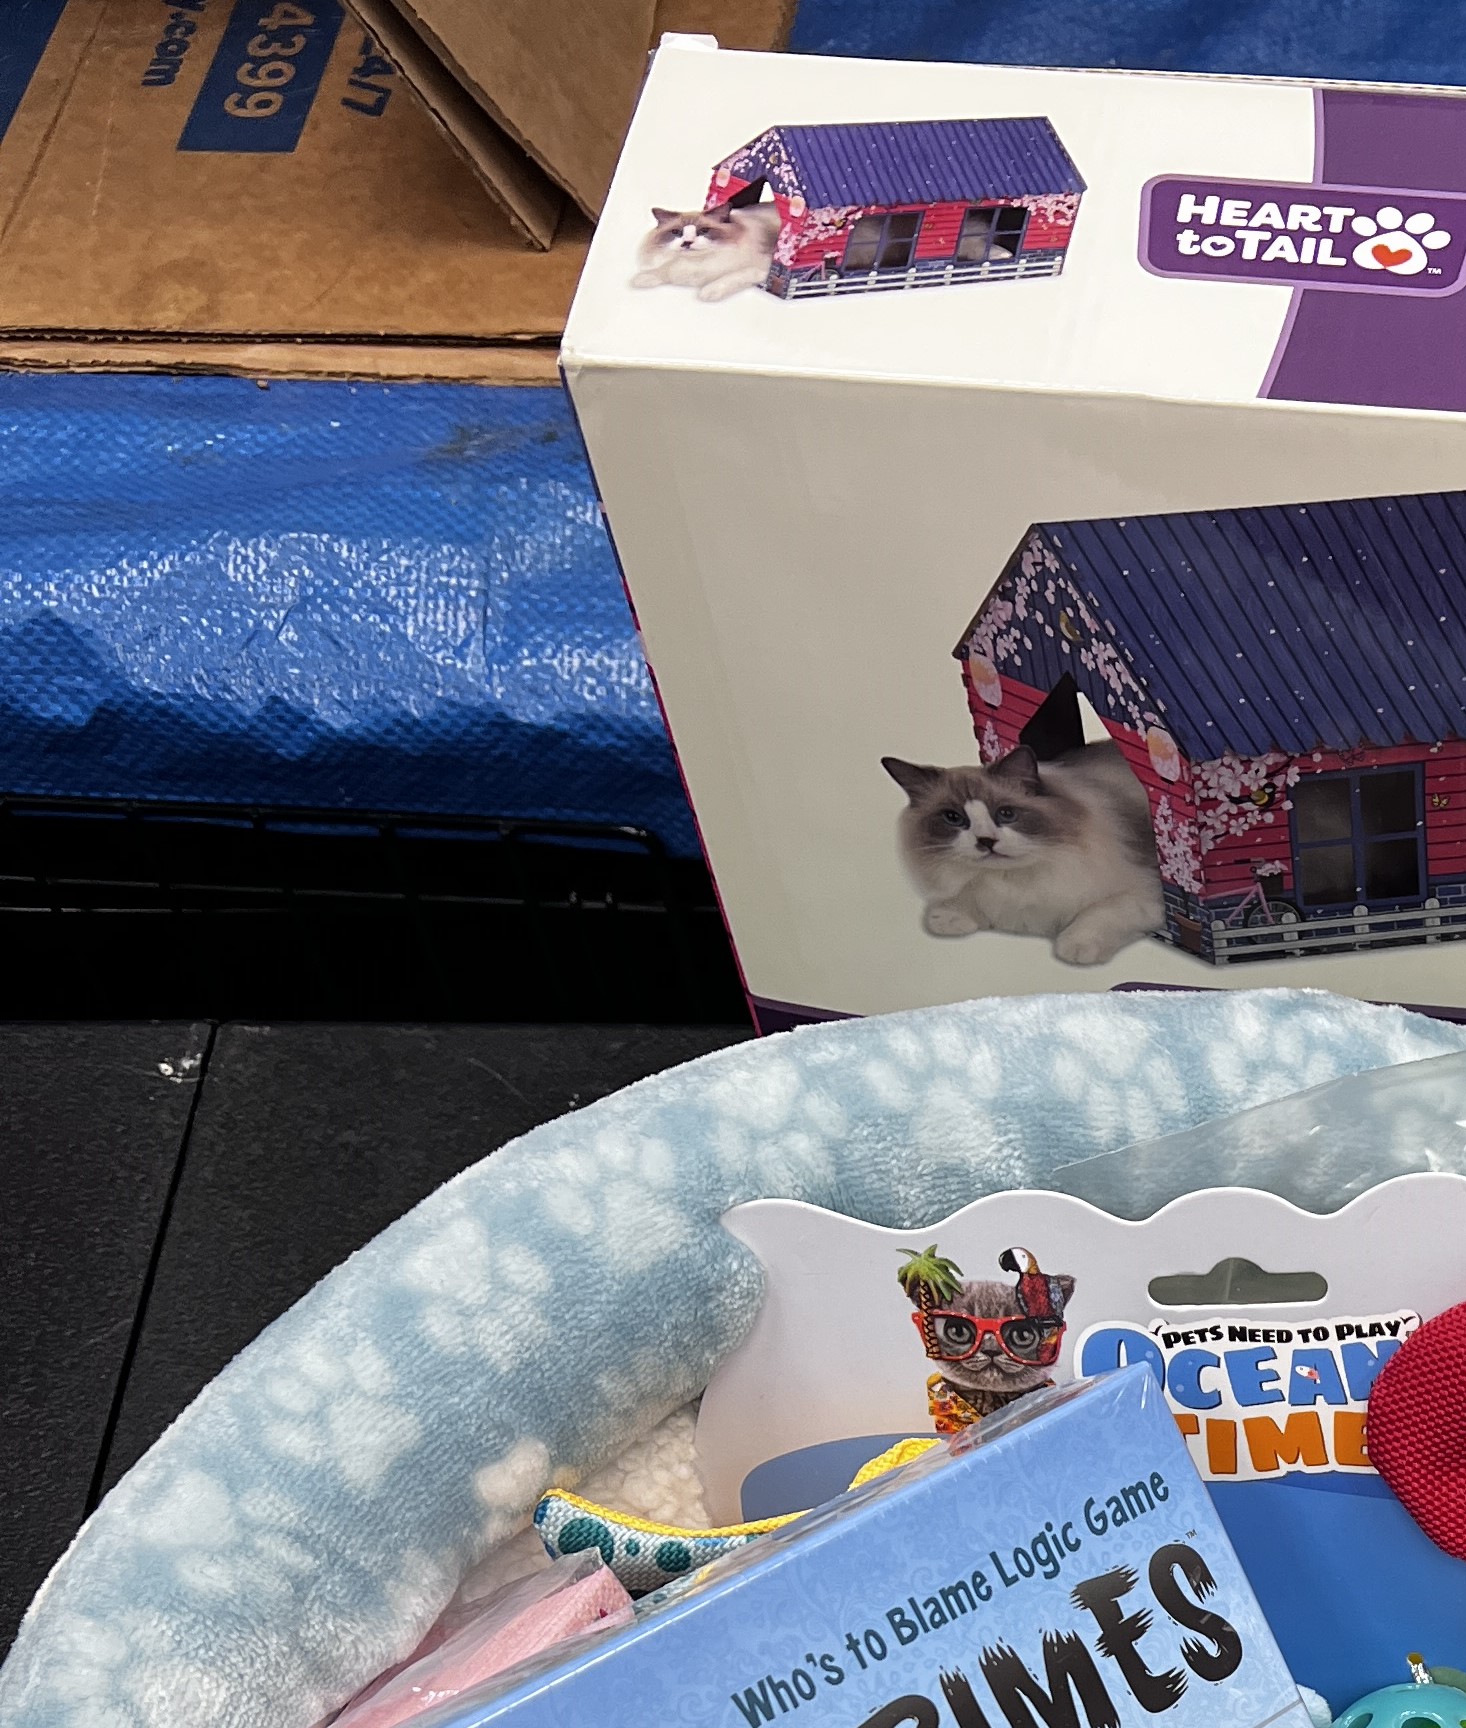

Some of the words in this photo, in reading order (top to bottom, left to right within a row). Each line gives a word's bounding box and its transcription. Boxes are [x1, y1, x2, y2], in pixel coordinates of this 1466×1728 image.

[223, 3, 316, 118] 4399
[1176, 193, 1355, 233] HEART
[1161, 1325, 1224, 1349] PETS
[1228, 1326, 1293, 1344] NEED
[1297, 1328, 1330, 1344] TO
[1335, 1320, 1401, 1341] PLAY
[845, 1627, 887, 1669] to
[886, 1570, 994, 1646] Blame
[990, 1521, 1082, 1589] Logic
[1083, 1471, 1170, 1535] Game
